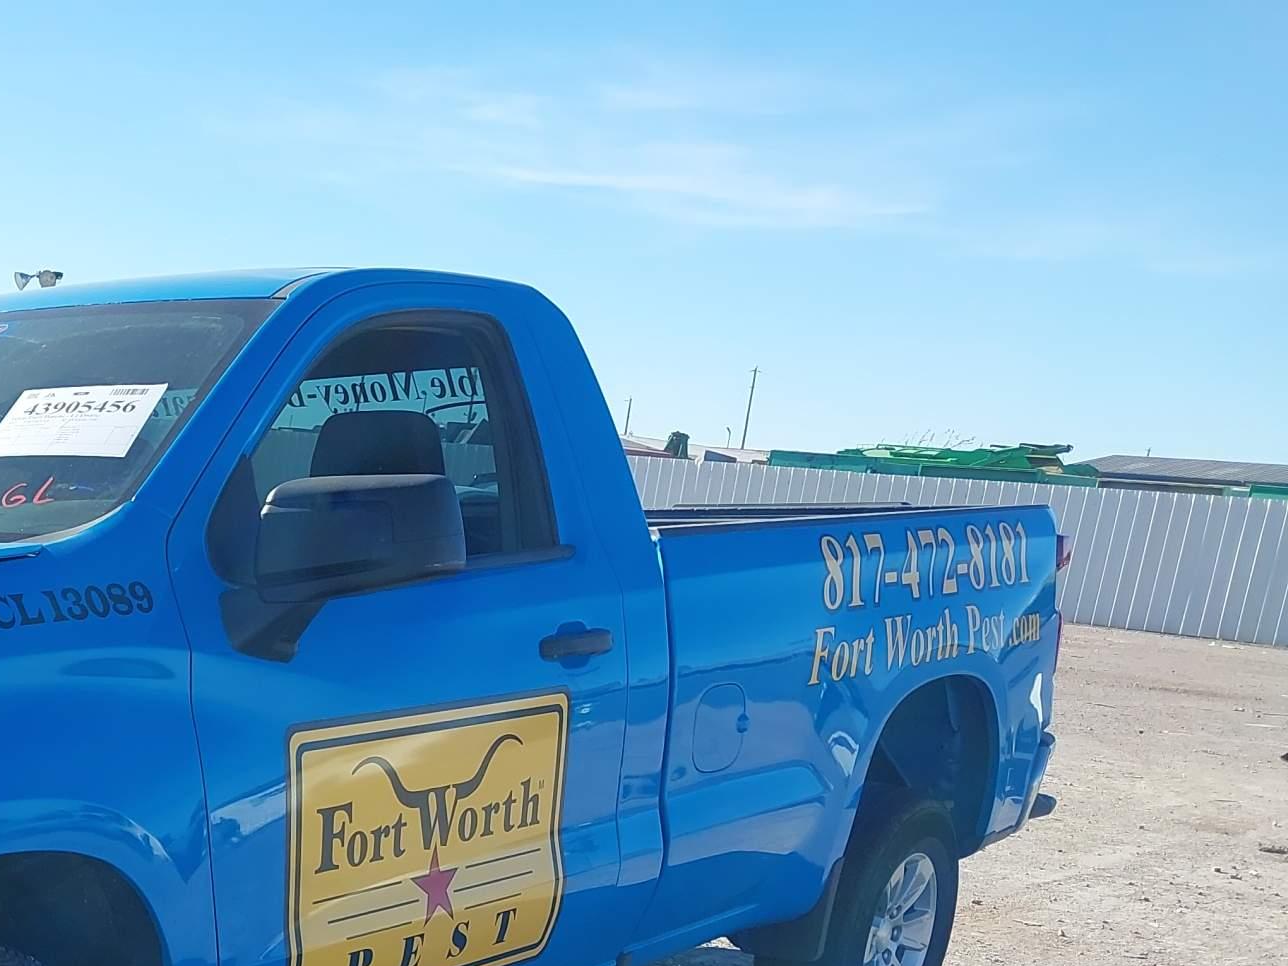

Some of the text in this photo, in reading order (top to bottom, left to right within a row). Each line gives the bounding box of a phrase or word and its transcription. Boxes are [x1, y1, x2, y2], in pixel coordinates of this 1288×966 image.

[24, 399, 140, 416] 43905456
[42, 581, 154, 622] 13089
[820, 522, 1030, 610] 817-472-8181
[808, 626, 875, 686] Fort
[884, 608, 959, 671] Worth
[965, 605, 1005, 655] Pest
[314, 777, 541, 875] Fort Worth
